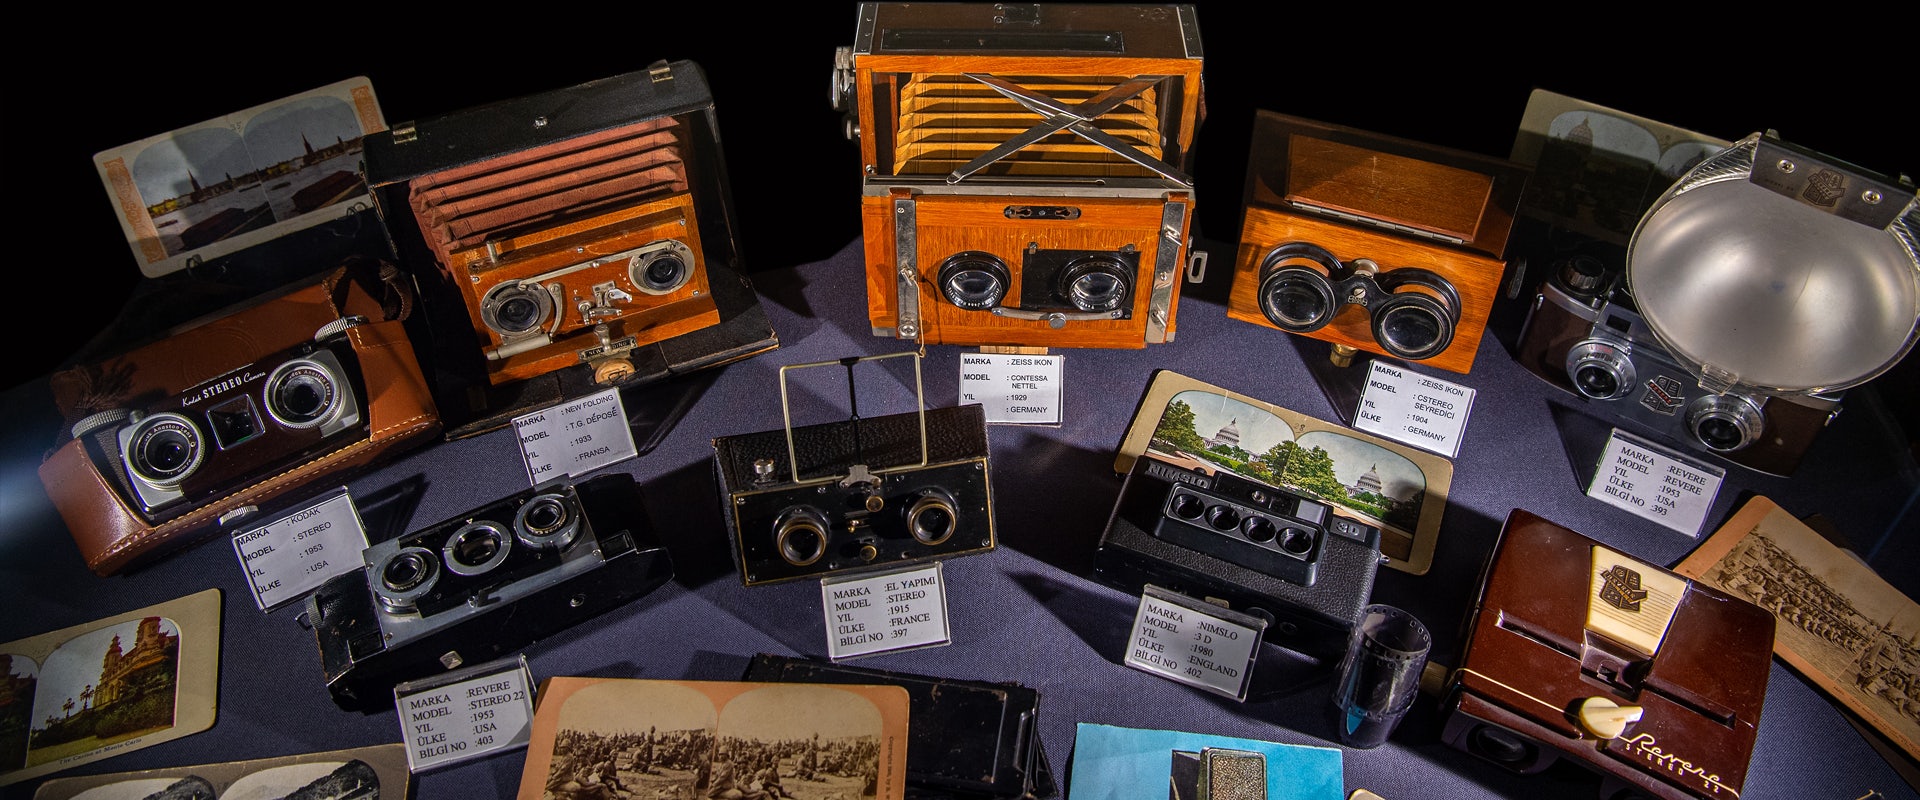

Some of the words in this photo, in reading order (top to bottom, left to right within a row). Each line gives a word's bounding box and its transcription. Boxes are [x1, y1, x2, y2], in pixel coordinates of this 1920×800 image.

[203, 376, 242, 399] STEREO
[1370, 381, 1396, 393] MODEL
[1418, 394, 1454, 410] CSTEREO
[1375, 365, 1402, 378] MARKA
[1422, 379, 1444, 391] ZEISS
[1445, 386, 1464, 397] IKON
[516, 415, 546, 428] MARKA
[565, 404, 581, 414] NEW
[583, 394, 614, 410] FOLDING
[522, 431, 549, 444] MODEL
[570, 421, 585, 430] T.G.
[586, 406, 618, 425] DÉPOSÉ
[1364, 400, 1376, 408] YIL
[1412, 414, 1428, 424] 1904
[575, 435, 592, 444] 1933
[1361, 410, 1381, 422] ÜLKE
[1408, 425, 1445, 442] GERMANY
[580, 446, 610, 460] FRANSA
[1621, 447, 1655, 465] MARKA
[1667, 465, 1707, 485] :REVERE
[1147, 463, 1209, 489] NIMSLO
[1614, 466, 1628, 478] YIL
[1659, 486, 1680, 498] :1953
[1617, 456, 1649, 474] MODEL
[1663, 475, 1702, 495] :REVERE
[1605, 485, 1629, 501] BİLGİ
[1631, 496, 1645, 507] NO
[1609, 476, 1634, 491] ÜLKE
[1655, 495, 1676, 508] :USA
[238, 528, 270, 545] MARKA
[291, 507, 320, 525] KODAK
[244, 545, 275, 561] MODEL
[298, 522, 331, 540] STEREO
[250, 568, 265, 578] YIL
[304, 544, 323, 556] 1953
[311, 560, 328, 572] USA
[834, 587, 871, 599] MARKA
[901, 577, 936, 589] YAPIMI
[835, 599, 871, 611] MODEL
[886, 590, 926, 604] :STEREO
[837, 614, 854, 622] YIL
[888, 605, 910, 615] :1915
[838, 623, 865, 634] ÜLKE
[889, 613, 930, 627] :FRANCE
[1147, 604, 1184, 623] MARKA
[1197, 621, 1238, 640] :NIMSLO
[840, 635, 866, 647] BİLGİ
[869, 632, 884, 642] NO
[1142, 627, 1158, 639] YIL
[1190, 644, 1214, 657] :1980
[1144, 616, 1179, 634] MODEL
[1204, 636, 1212, 644] D
[1134, 649, 1161, 664] BİLGİ
[1163, 660, 1178, 669] NO
[1138, 638, 1165, 654] ÜLKE
[1188, 655, 1238, 678] :ENGLAND
[411, 694, 452, 710] MARKA
[466, 681, 511, 698] :REVERE
[413, 707, 452, 722] MODEL
[468, 694, 511, 710] :STEREO
[514, 691, 524, 700] 22
[416, 724, 433, 734] YIL
[471, 710, 495, 722] :1953
[417, 733, 447, 747] ÜLKE
[473, 723, 497, 735] :USA
[419, 743, 449, 759] BİLGİ
[451, 742, 467, 752] NO
[1624, 733, 1730, 790] Revere
[1625, 743, 1684, 775] STEREO
[1704, 781, 1720, 793] 22
